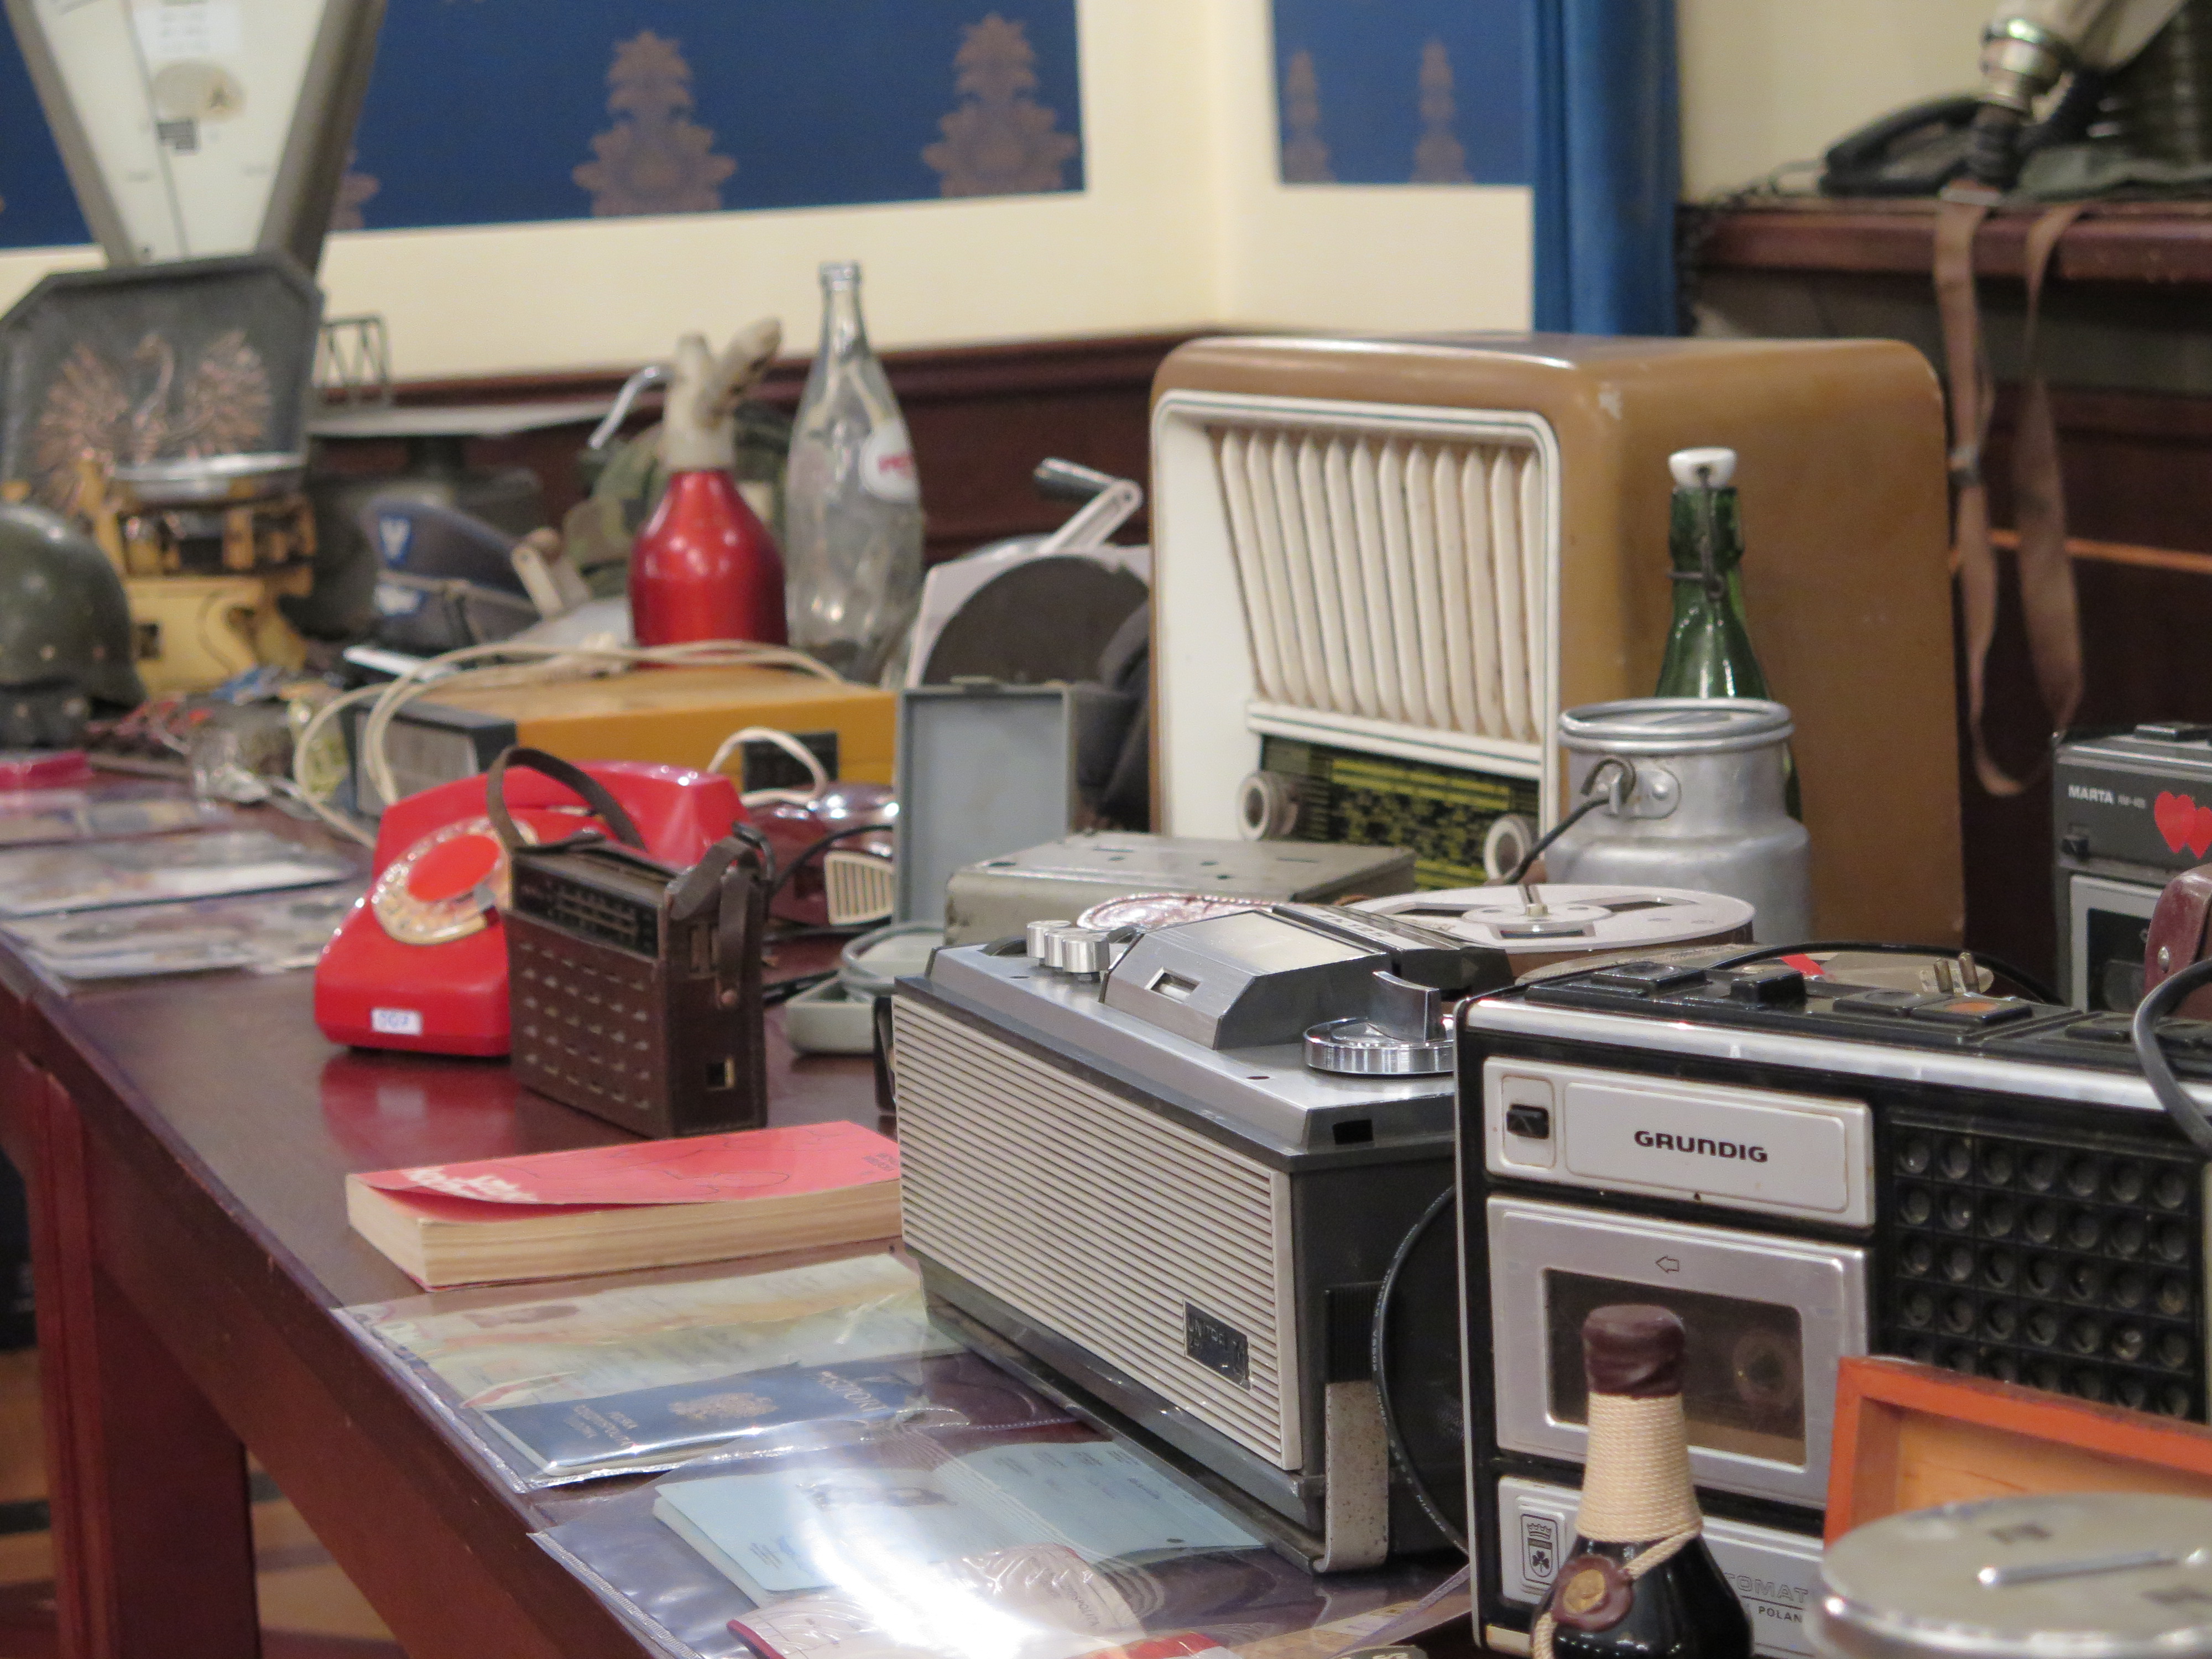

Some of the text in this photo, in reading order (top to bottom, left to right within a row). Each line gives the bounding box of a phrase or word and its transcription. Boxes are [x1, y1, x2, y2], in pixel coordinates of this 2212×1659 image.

[1634, 1130, 1768, 1162] GRUNDIG
[1723, 1572, 1809, 1603] TOMAT
[1758, 1606, 1802, 1624] POLAN
